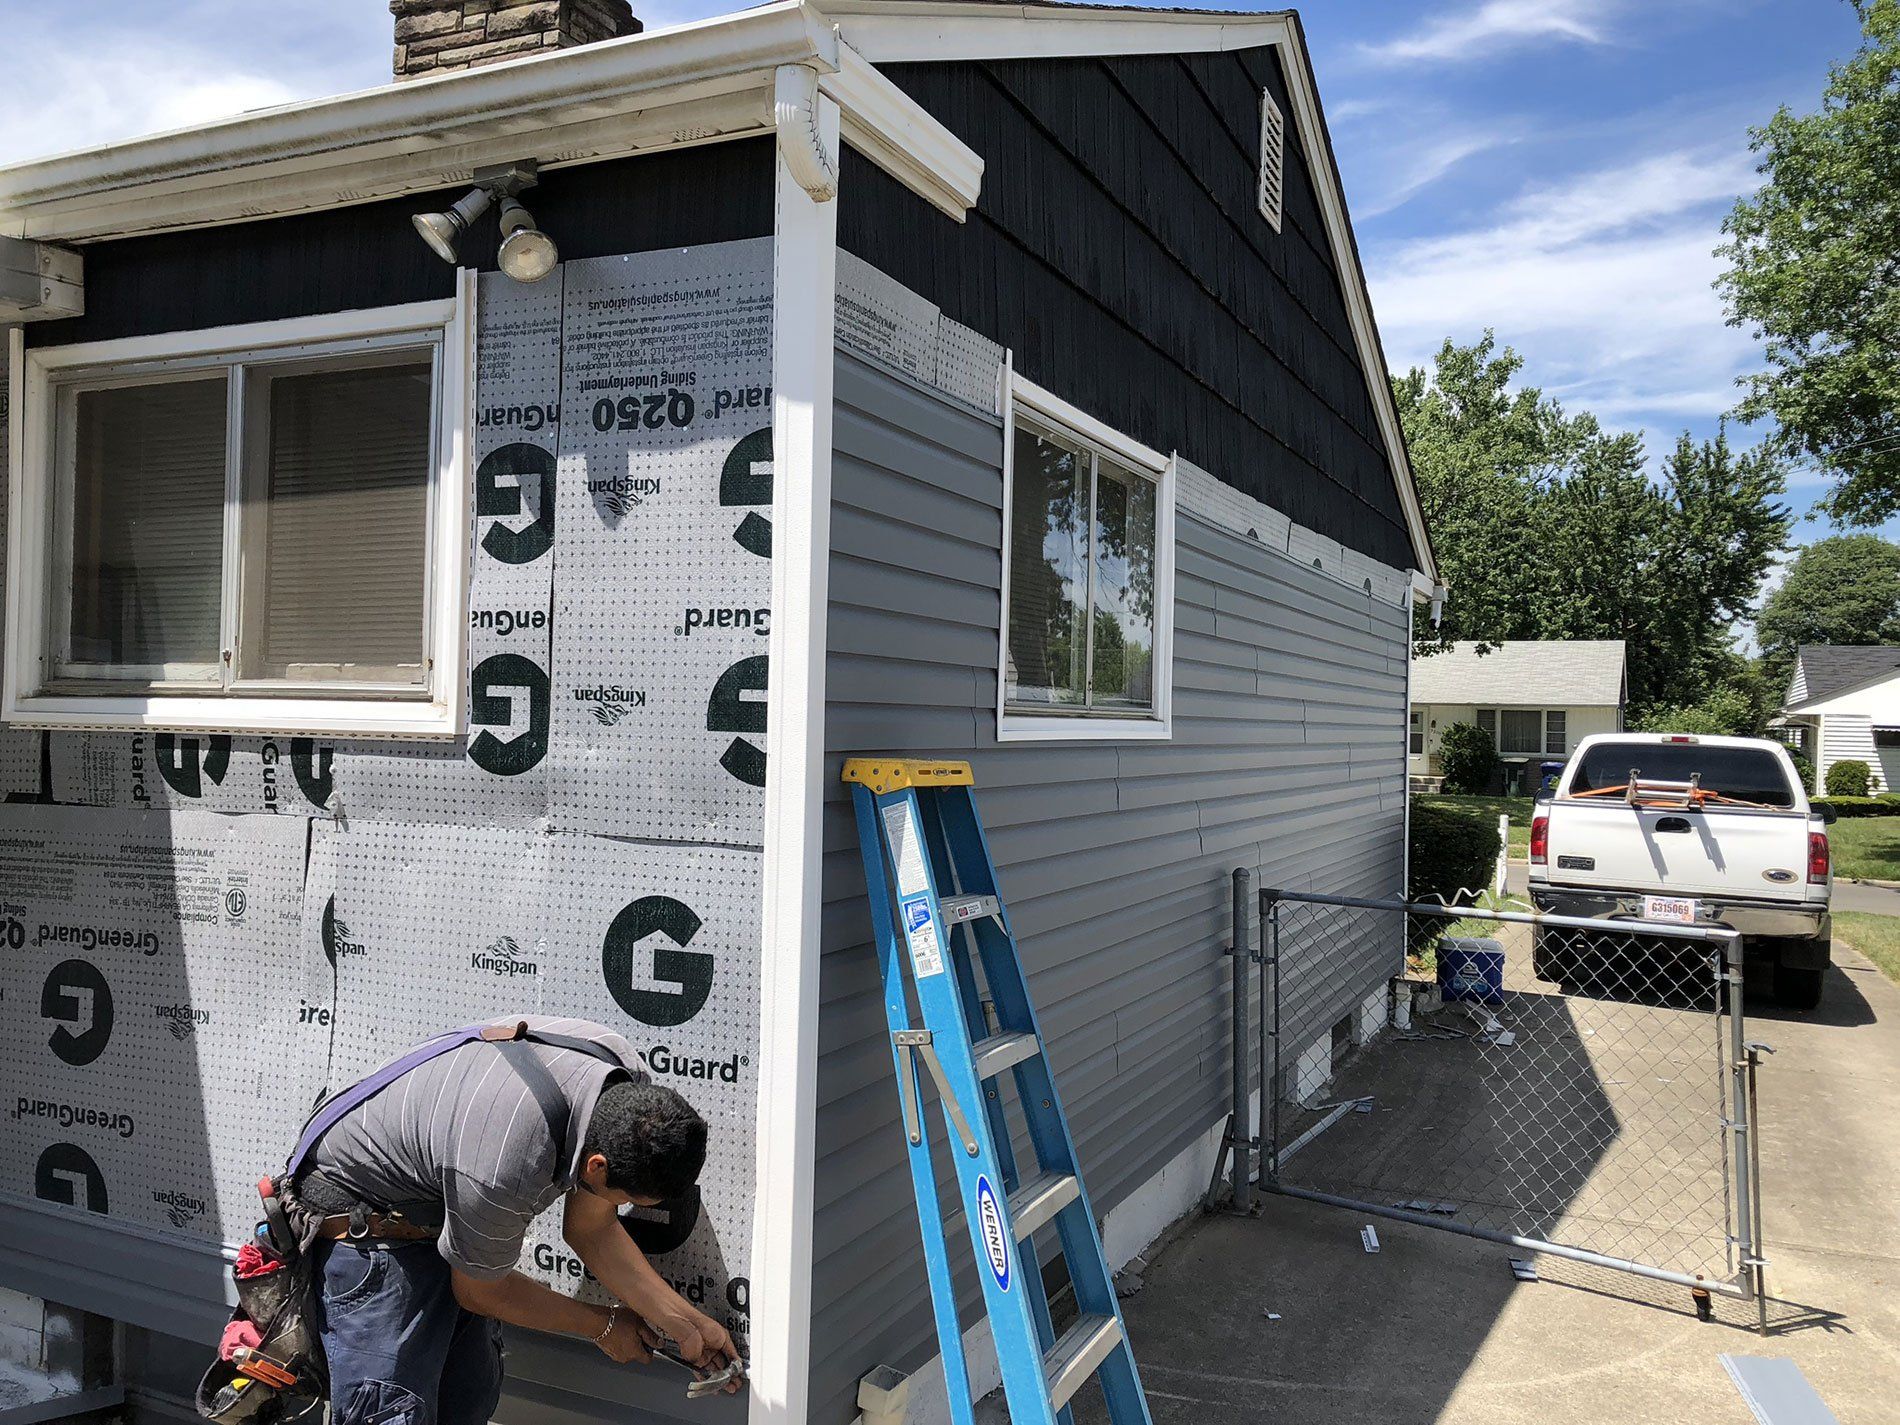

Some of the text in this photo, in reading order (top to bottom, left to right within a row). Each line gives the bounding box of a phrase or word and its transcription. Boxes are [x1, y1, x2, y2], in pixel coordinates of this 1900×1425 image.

[588, 287, 720, 311] www.kingspaninsulation.us
[579, 370, 696, 394] Siding Underlayment
[476, 404, 559, 432] nGuar
[592, 389, 695, 432] Q250
[586, 475, 661, 495] Kingspan
[572, 686, 646, 707] Kingspan
[3, 902, 27, 917] Siding
[172, 912, 219, 925] Compliance
[471, 953, 537, 977] Kingspan
[153, 1003, 210, 1025] Kingspan
[152, 1191, 205, 1217] Kingspan
[983, 1199, 1004, 1269] WERNER
